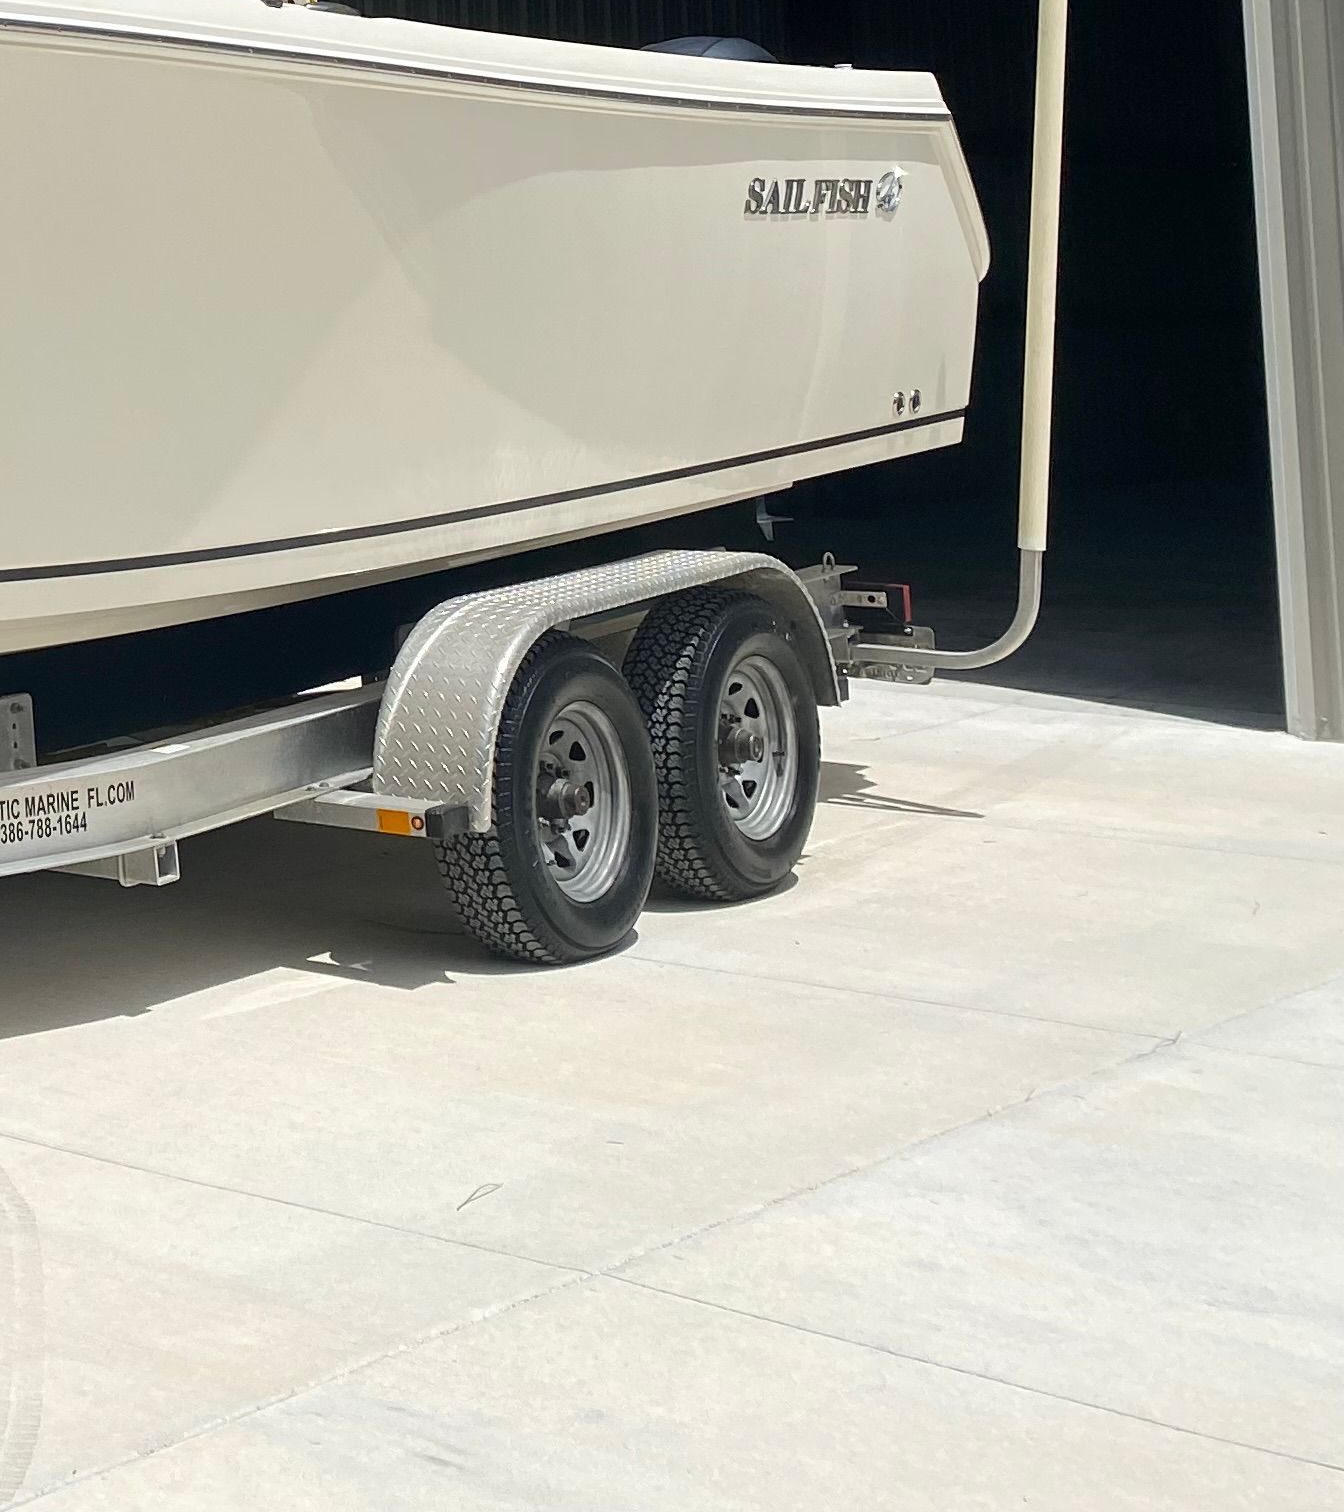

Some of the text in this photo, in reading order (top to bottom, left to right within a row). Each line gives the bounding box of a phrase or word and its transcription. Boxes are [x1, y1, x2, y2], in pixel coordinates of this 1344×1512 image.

[25, 789, 80, 818] MARINE
[87, 780, 135, 808] FL.COM
[0, 811, 88, 845] 386-788-1644
